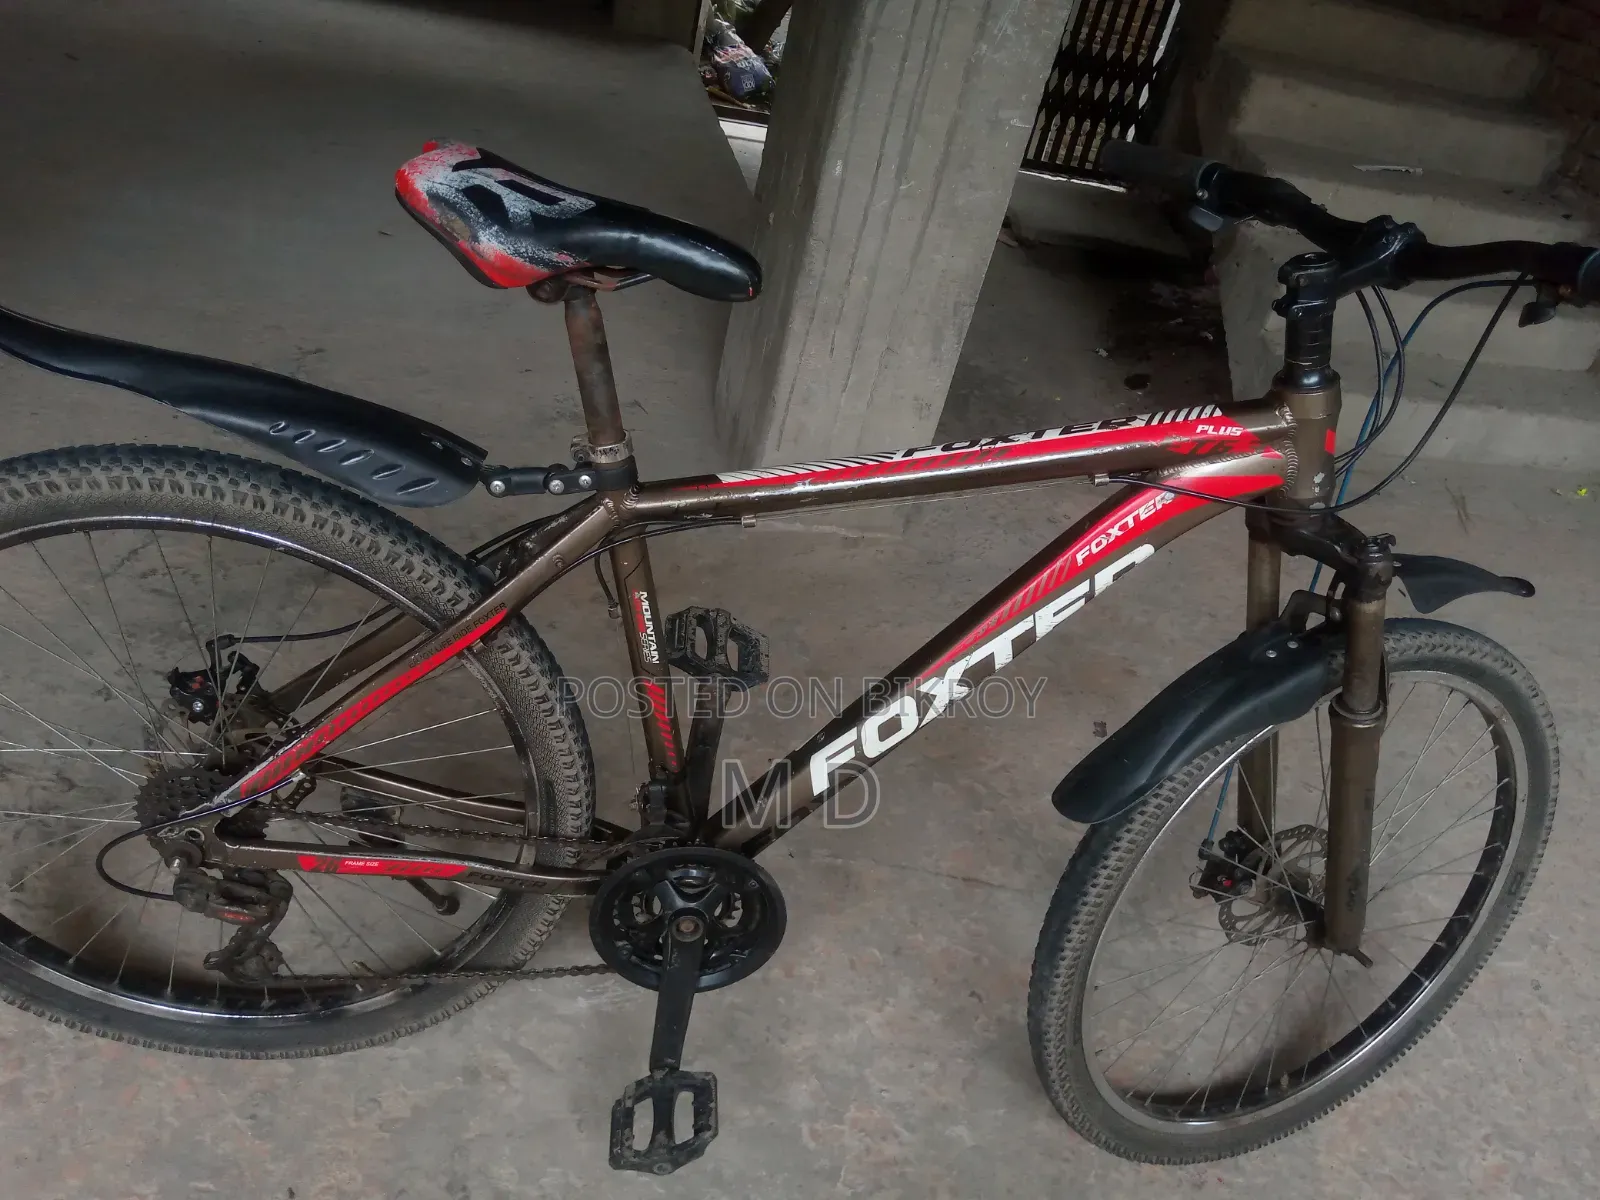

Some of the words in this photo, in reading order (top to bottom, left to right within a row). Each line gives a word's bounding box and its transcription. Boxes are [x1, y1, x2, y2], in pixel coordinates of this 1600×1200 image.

[901, 415, 1146, 458] FOXTER
[1195, 424, 1243, 436] PLUS
[1075, 490, 1175, 567] FOXTER
[474, 601, 508, 628] FOXTER
[640, 590, 660, 664] MOUNTAIN
